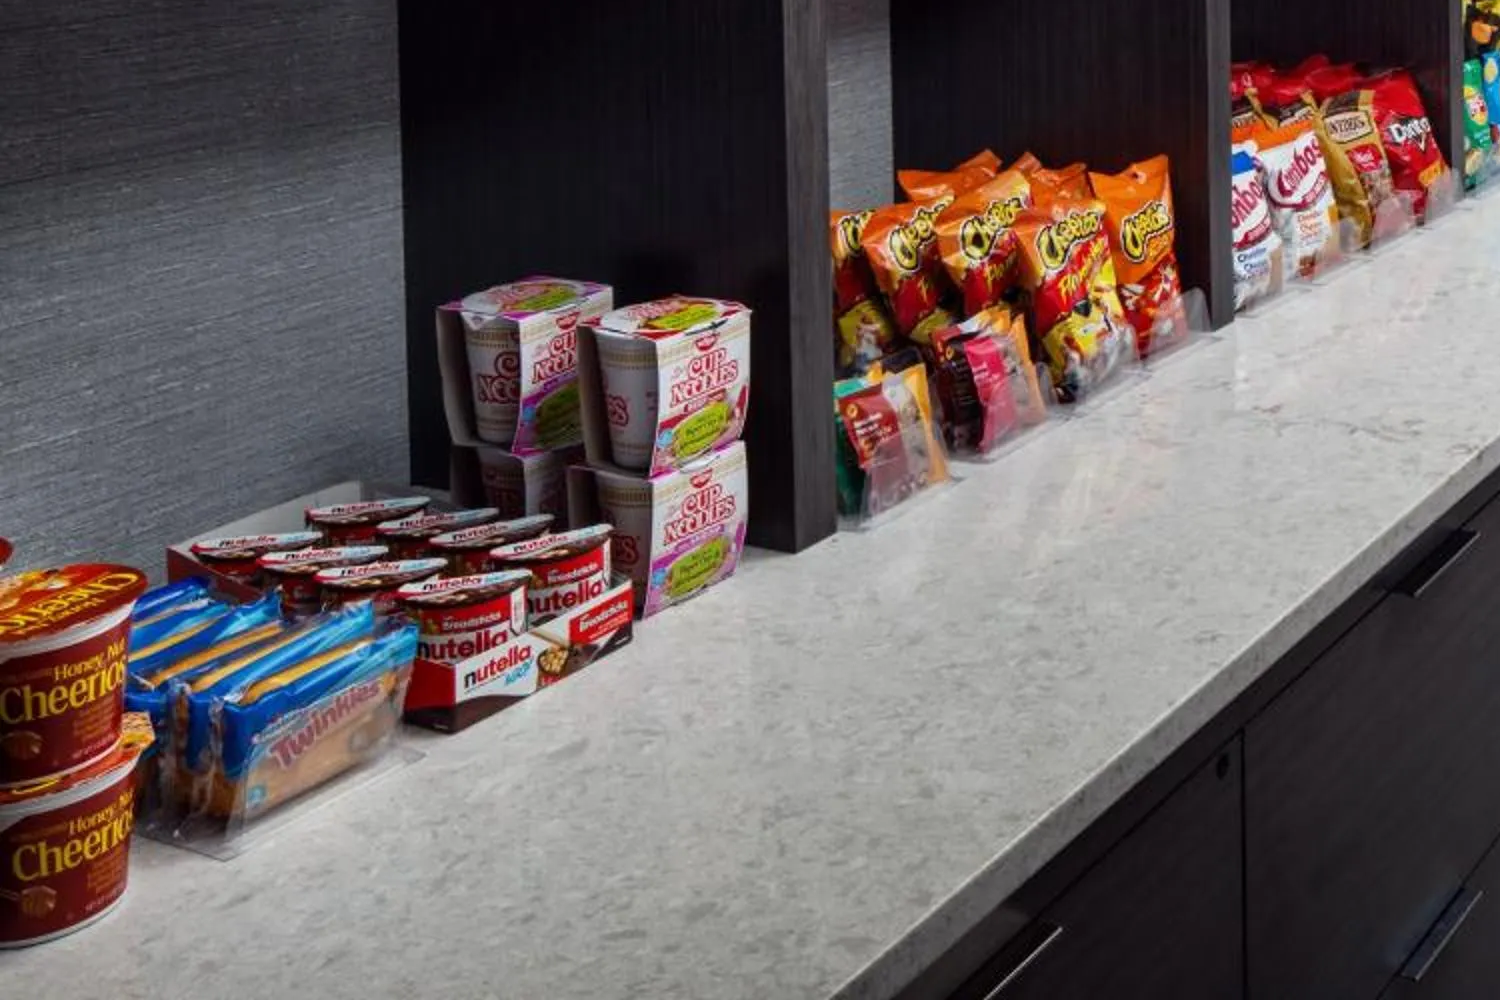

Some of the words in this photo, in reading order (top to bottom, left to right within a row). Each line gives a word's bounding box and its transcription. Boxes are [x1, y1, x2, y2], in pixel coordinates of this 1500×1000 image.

[688, 347, 727, 379] CUP
[670, 360, 739, 408] NOODLES
[680, 483, 723, 518] CUP
[663, 495, 736, 546] NOODLES
[422, 577, 483, 591] nutella
[418, 629, 508, 660] nutella
[54, 652, 106, 682] Honey
[464, 644, 531, 689] nutella
[270, 680, 381, 771] Twinkies
[69, 804, 115, 836] Honey
